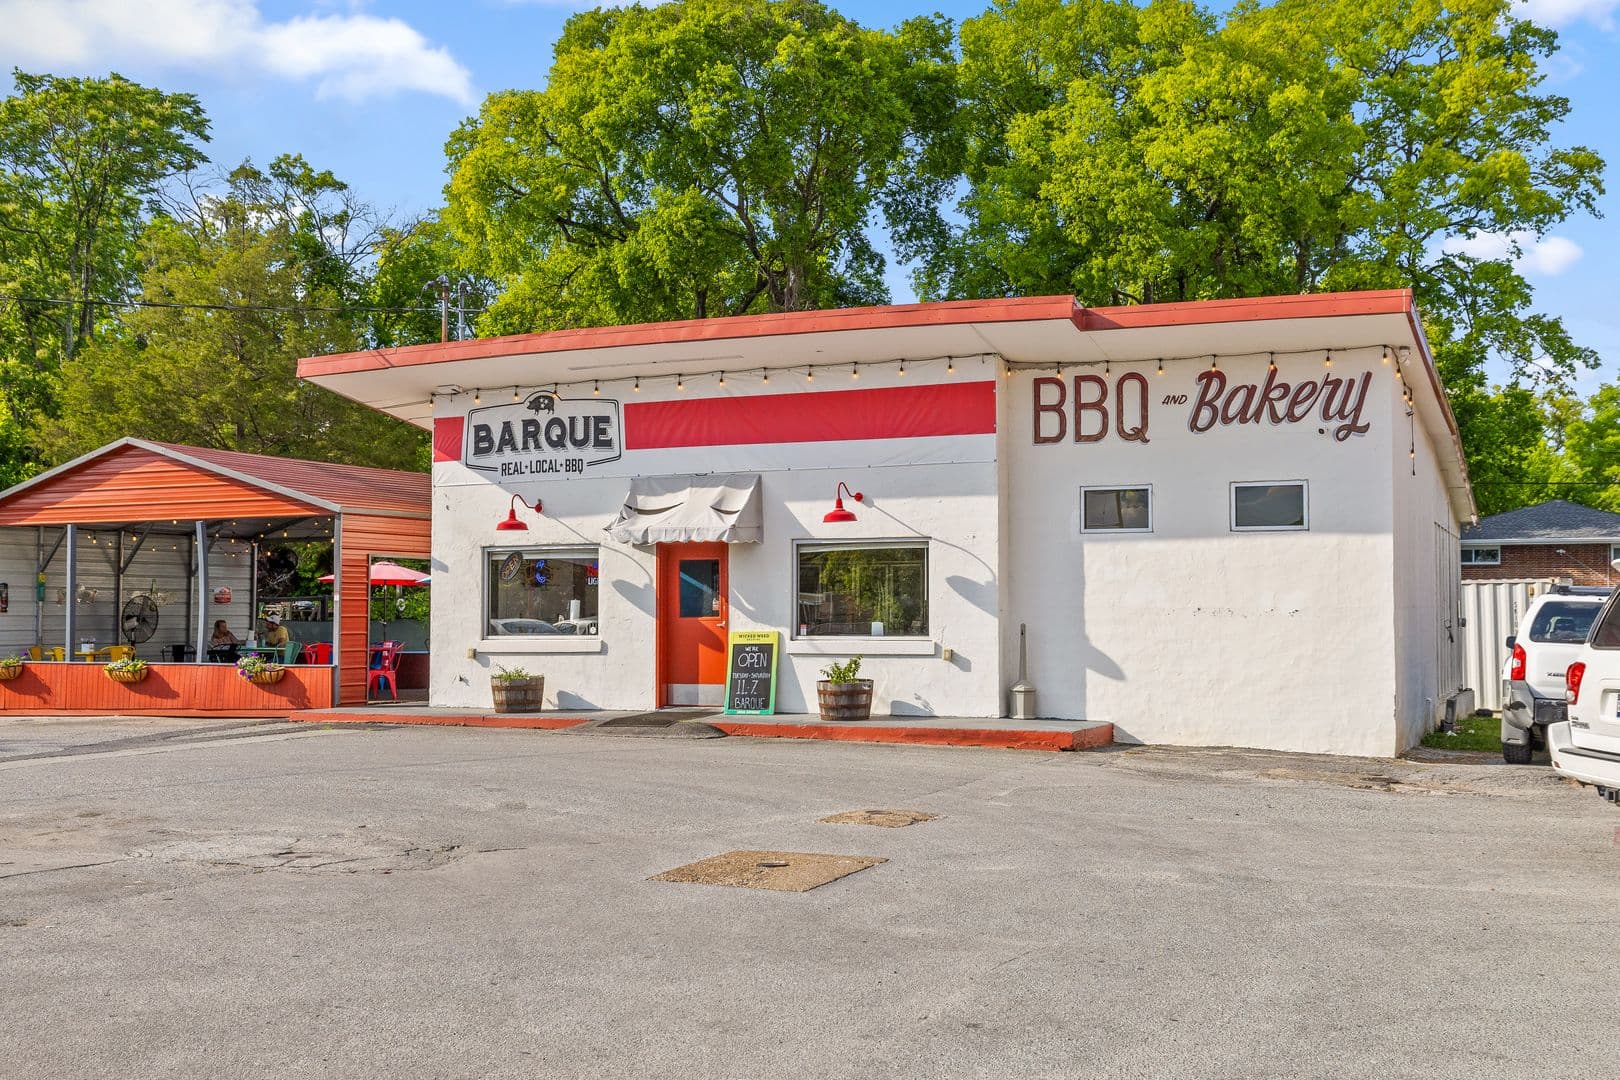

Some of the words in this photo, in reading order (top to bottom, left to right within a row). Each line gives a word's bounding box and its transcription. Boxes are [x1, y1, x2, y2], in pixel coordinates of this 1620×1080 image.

[1032, 372, 1150, 446] BBQ
[1162, 394, 1188, 406] AND
[1188, 366, 1372, 442] Bakery
[473, 416, 614, 457] BARQUE
[501, 461, 525, 476] REAL
[530, 460, 560, 474] LOCAL
[565, 459, 583, 474] BBQ
[738, 652, 768, 668] OPEN
[735, 697, 766, 710] BARQUE
